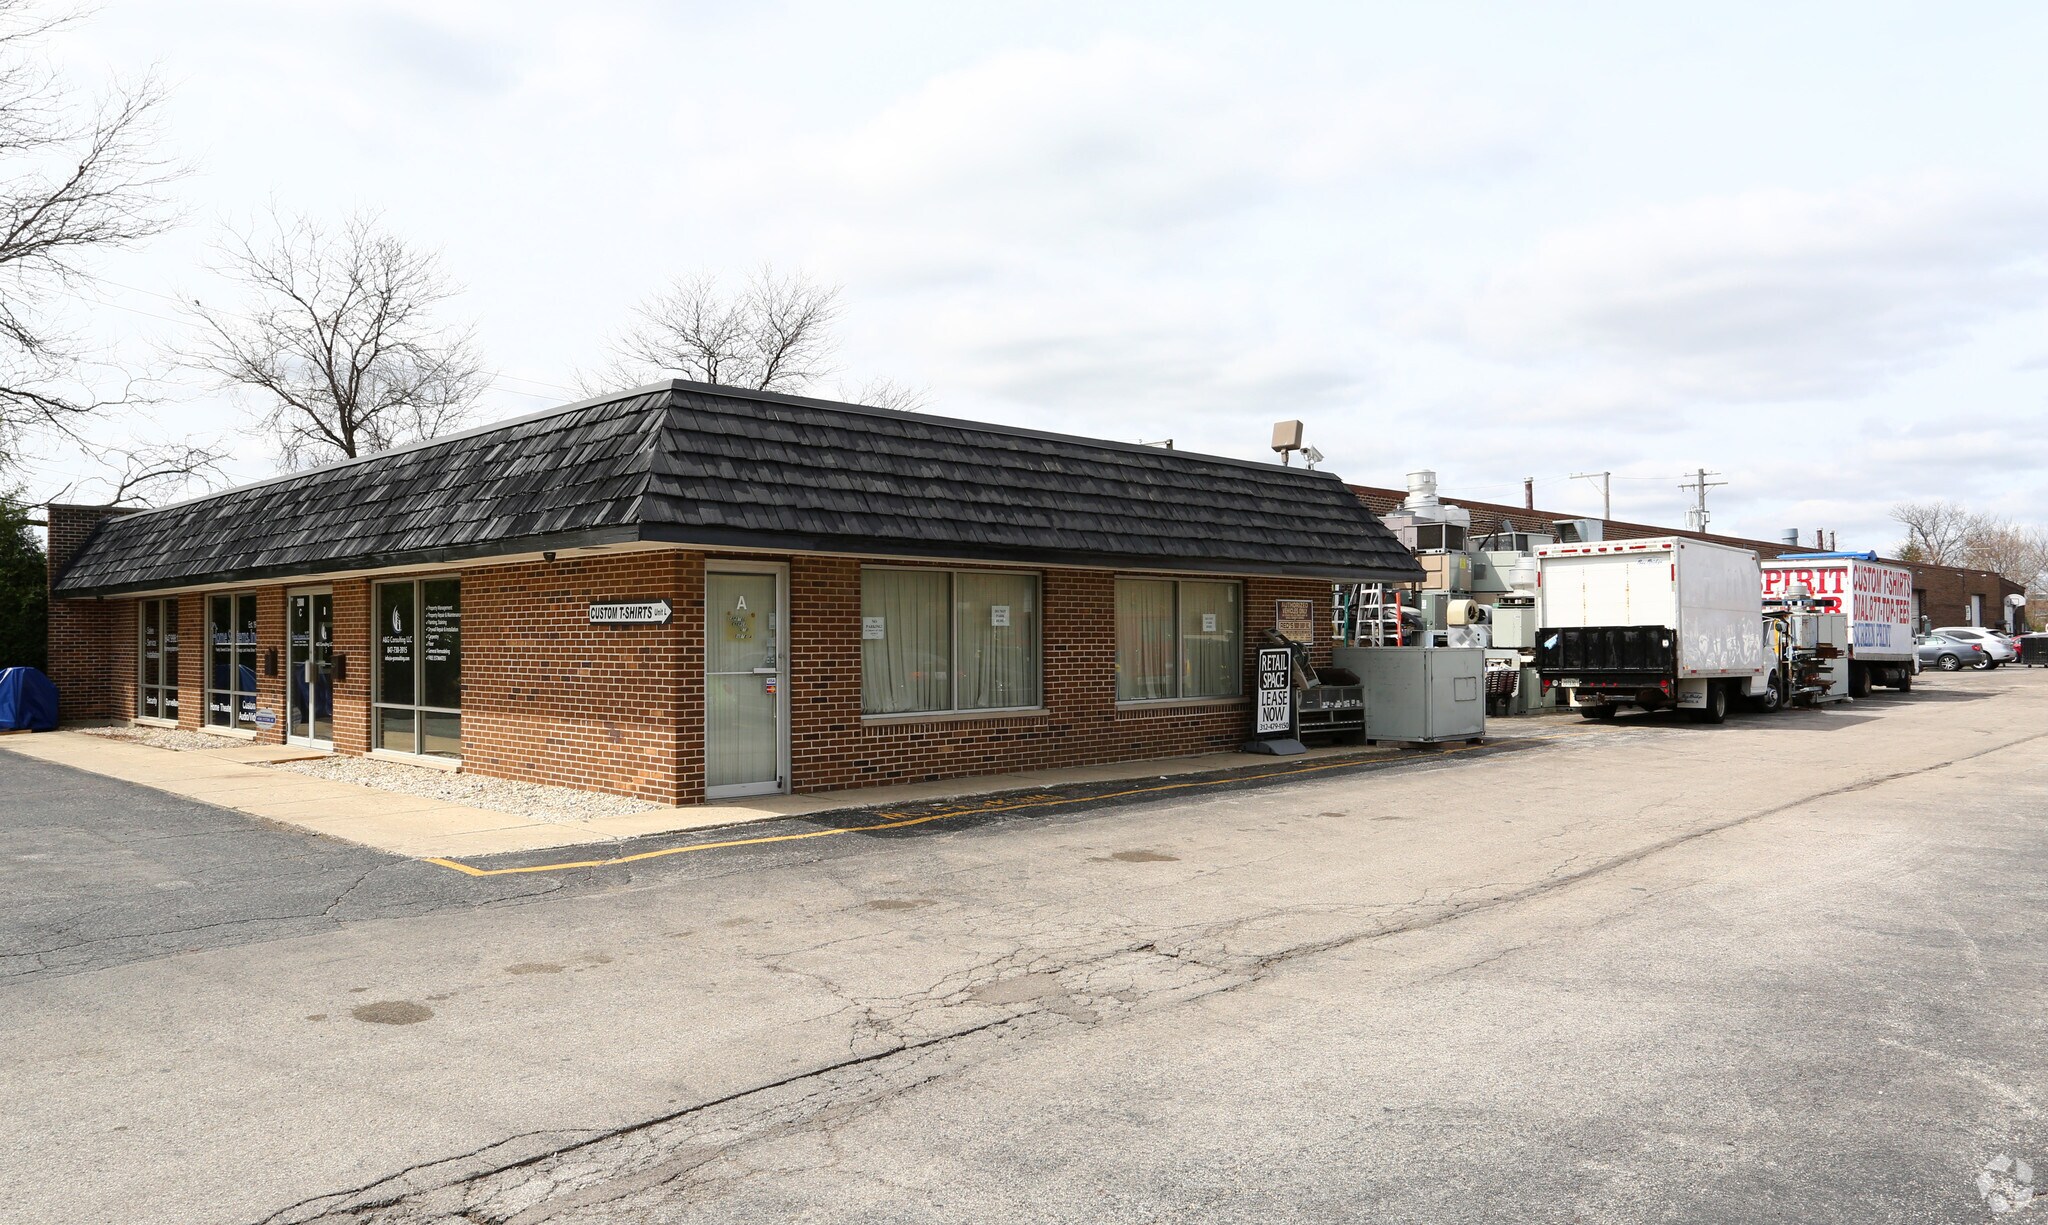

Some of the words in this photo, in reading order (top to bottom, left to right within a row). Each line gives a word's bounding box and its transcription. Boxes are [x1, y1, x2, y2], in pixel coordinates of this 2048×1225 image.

[1761, 568, 1848, 595] PIRIT
[1853, 564, 1882, 594] CUSTOM
[1883, 569, 1911, 598] T-SHIRTS
[736, 595, 748, 610] A
[1853, 594, 1868, 621] DIAL
[1869, 595, 1910, 625] 877-TOP-TEES
[591, 607, 618, 620] CUSTOM
[620, 606, 652, 619] T-SHIRTS
[1262, 654, 1288, 672] RETAIL
[1262, 672, 1285, 688] SPACE
[1262, 690, 1288, 706] LEASE
[1262, 706, 1286, 722] NOW
